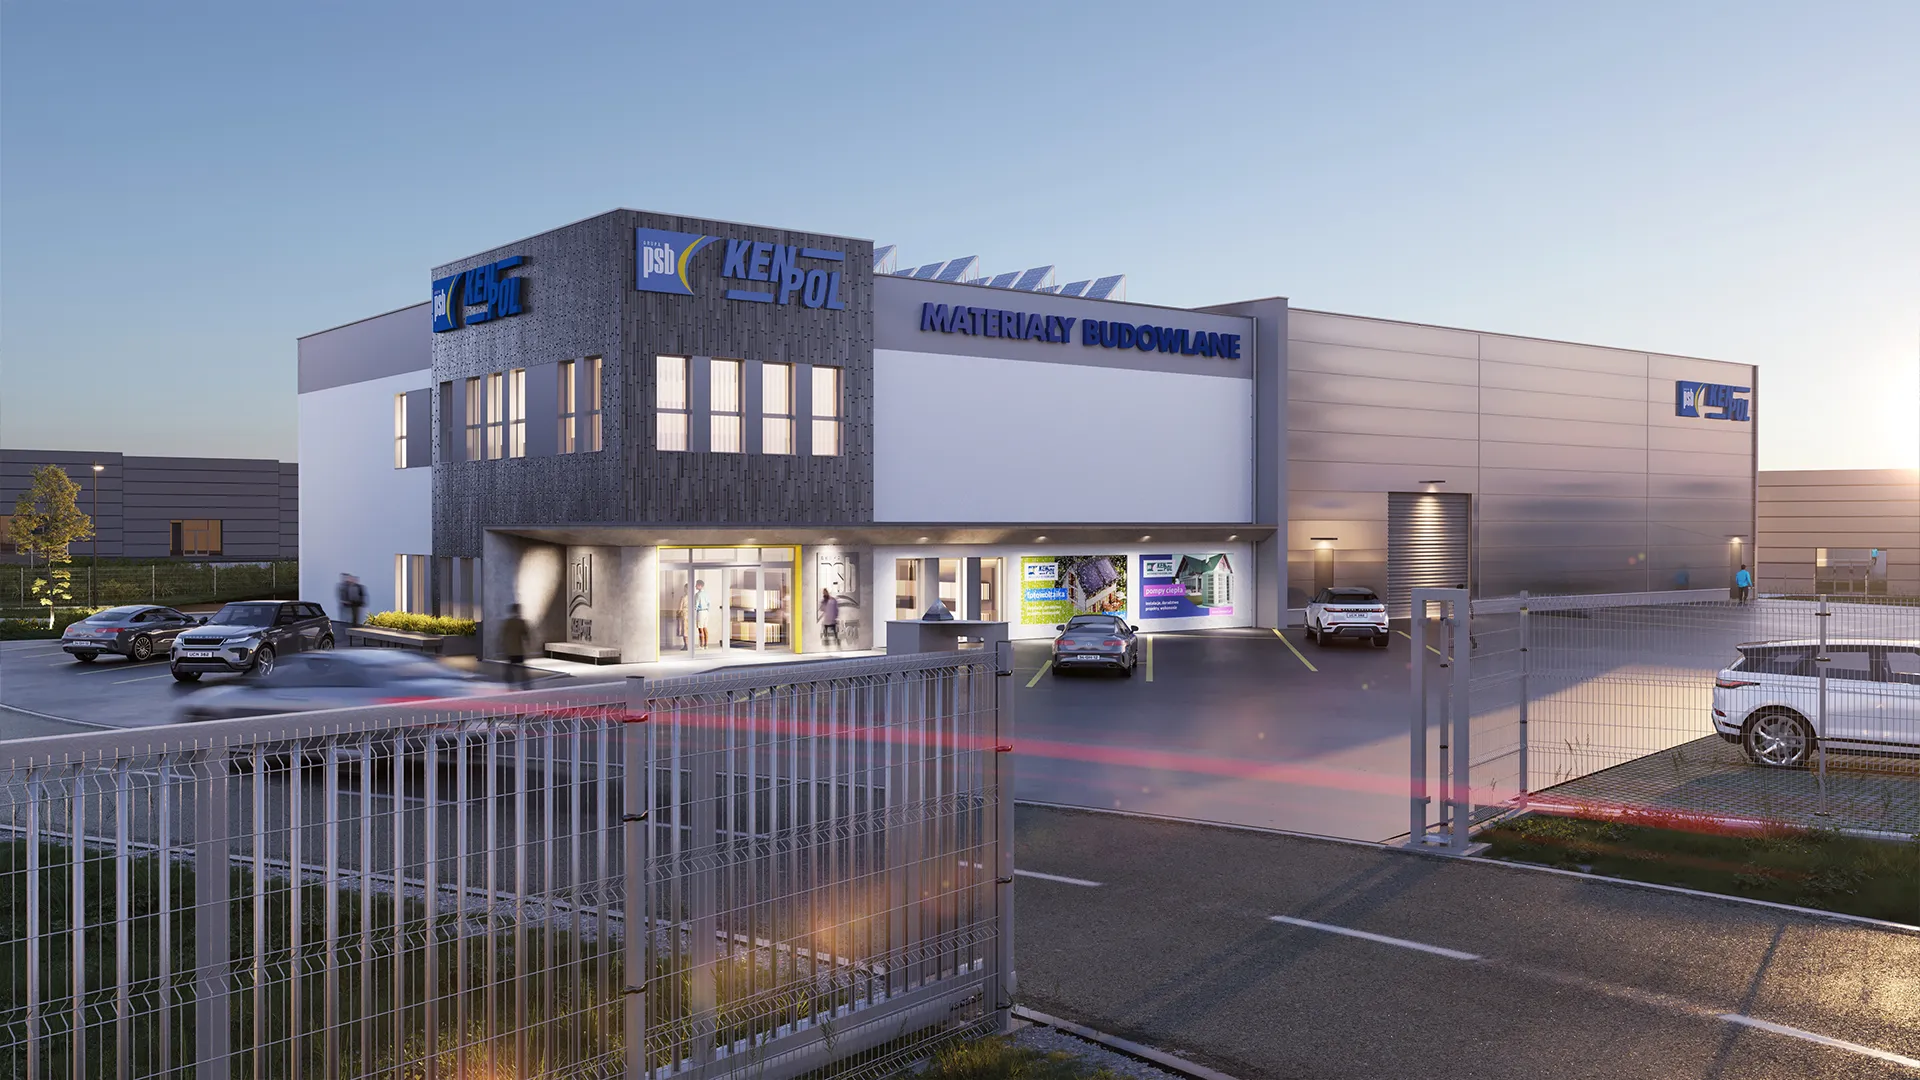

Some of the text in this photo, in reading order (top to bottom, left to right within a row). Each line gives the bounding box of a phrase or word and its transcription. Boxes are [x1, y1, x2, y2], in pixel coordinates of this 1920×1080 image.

[643, 243, 675, 279] psb
[920, 302, 1241, 359] MATERIAŁY BUDOWLANE
[1145, 587, 1184, 596] pompy ciepła
